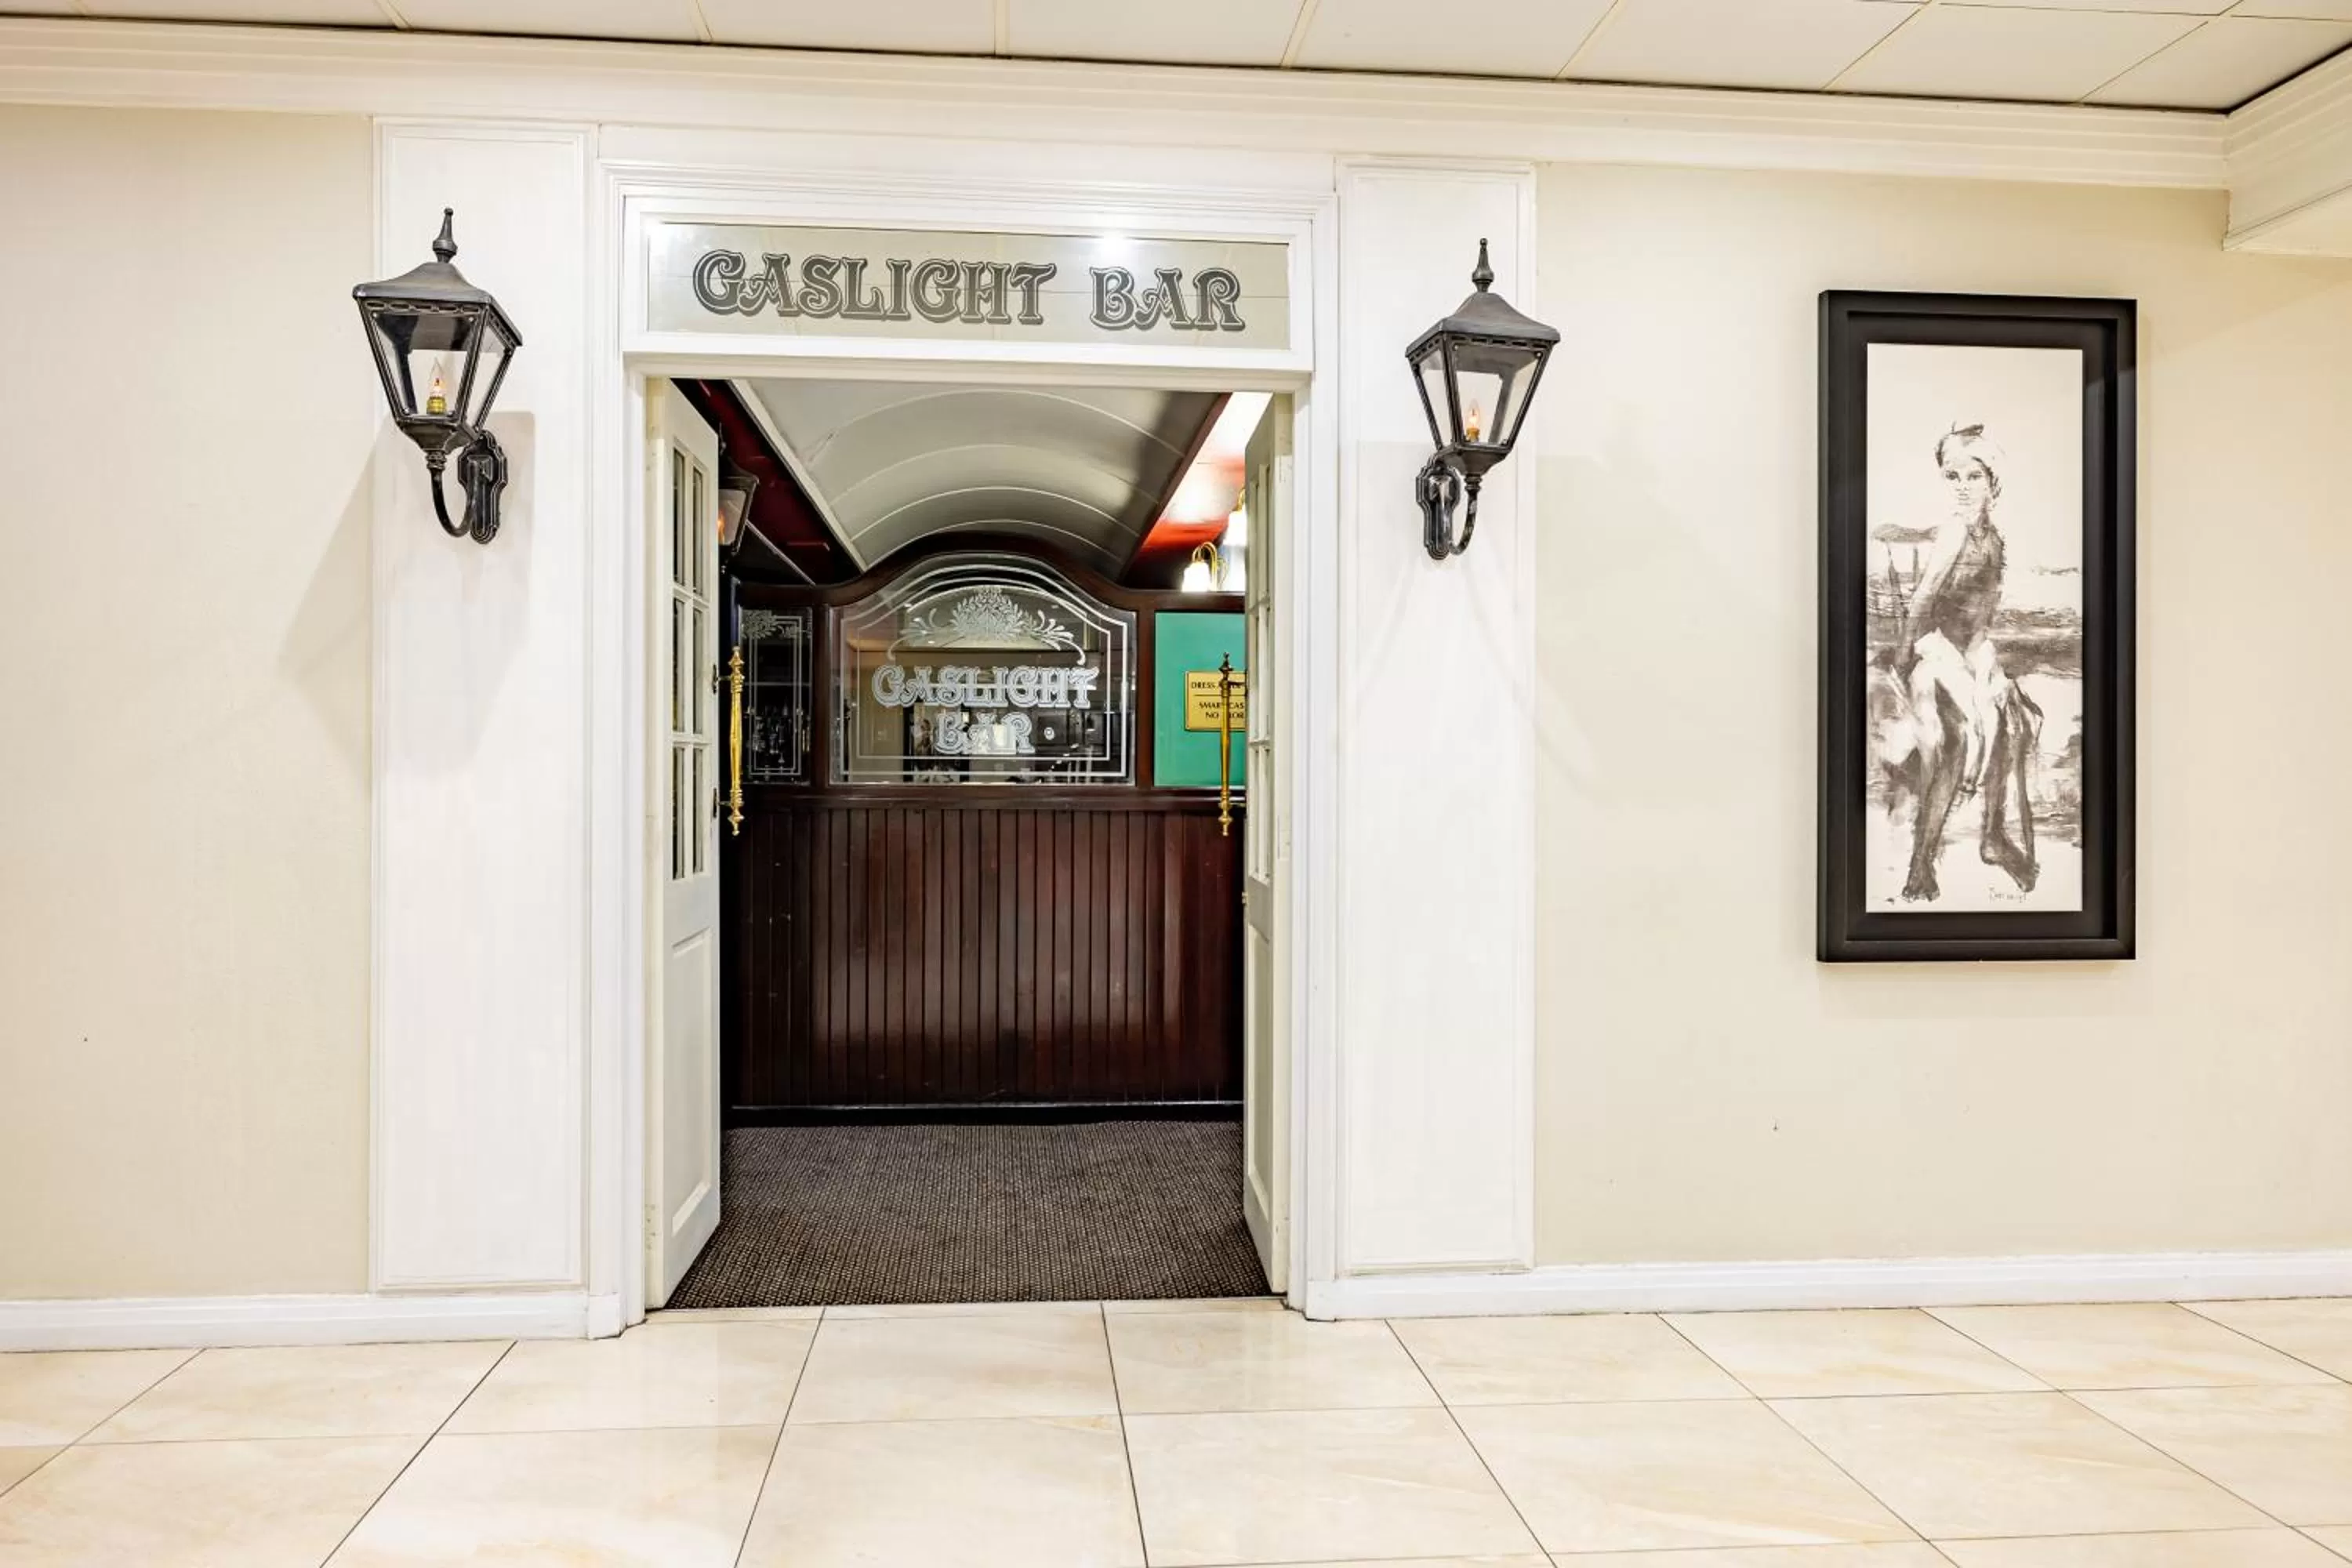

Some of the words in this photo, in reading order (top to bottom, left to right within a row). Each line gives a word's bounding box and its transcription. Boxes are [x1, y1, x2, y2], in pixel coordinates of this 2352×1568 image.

[693, 250, 1056, 325] GASLIGHT
[1089, 267, 1246, 331] BAR
[872, 664, 1099, 709] GASLIGHT
[935, 711, 1036, 755] BAR
